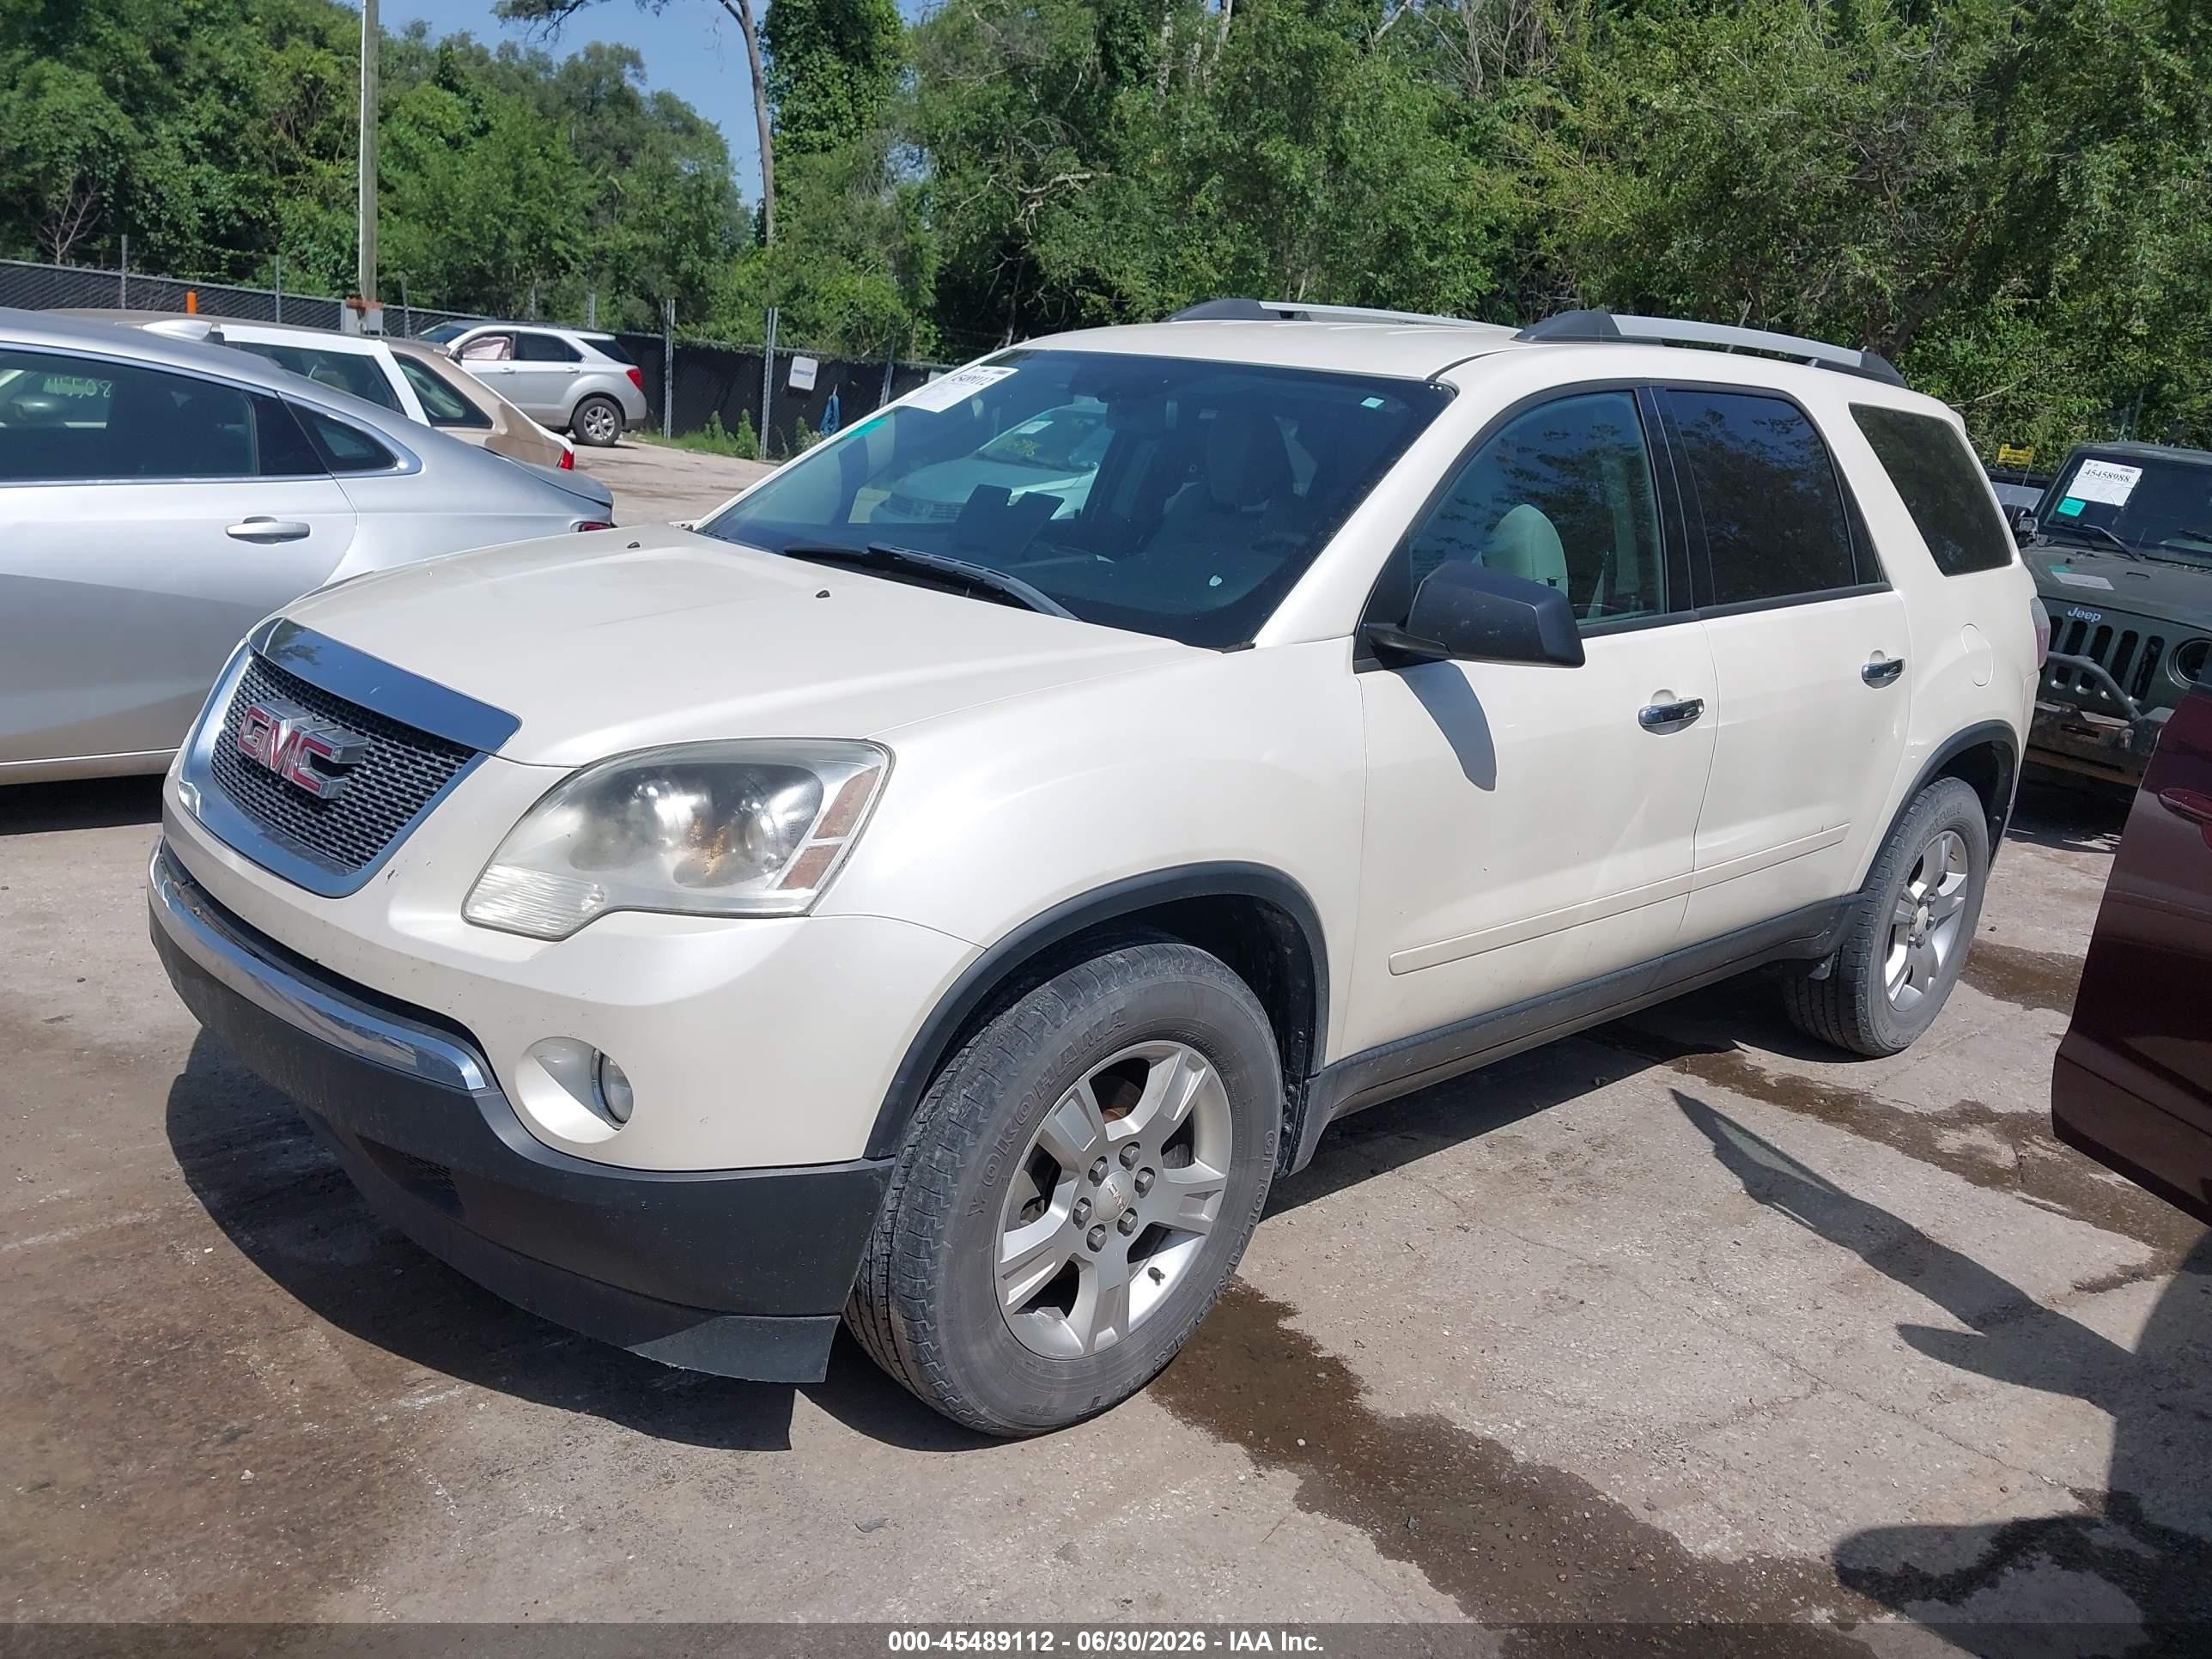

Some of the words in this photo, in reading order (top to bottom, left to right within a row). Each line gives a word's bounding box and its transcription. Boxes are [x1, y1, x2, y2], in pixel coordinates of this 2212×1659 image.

[2084, 468, 2131, 483] 45458988
[2067, 606, 2101, 623] Jeep
[237, 700, 365, 800] GMC
[967, 1003, 1127, 1217] YOKOHAMA
